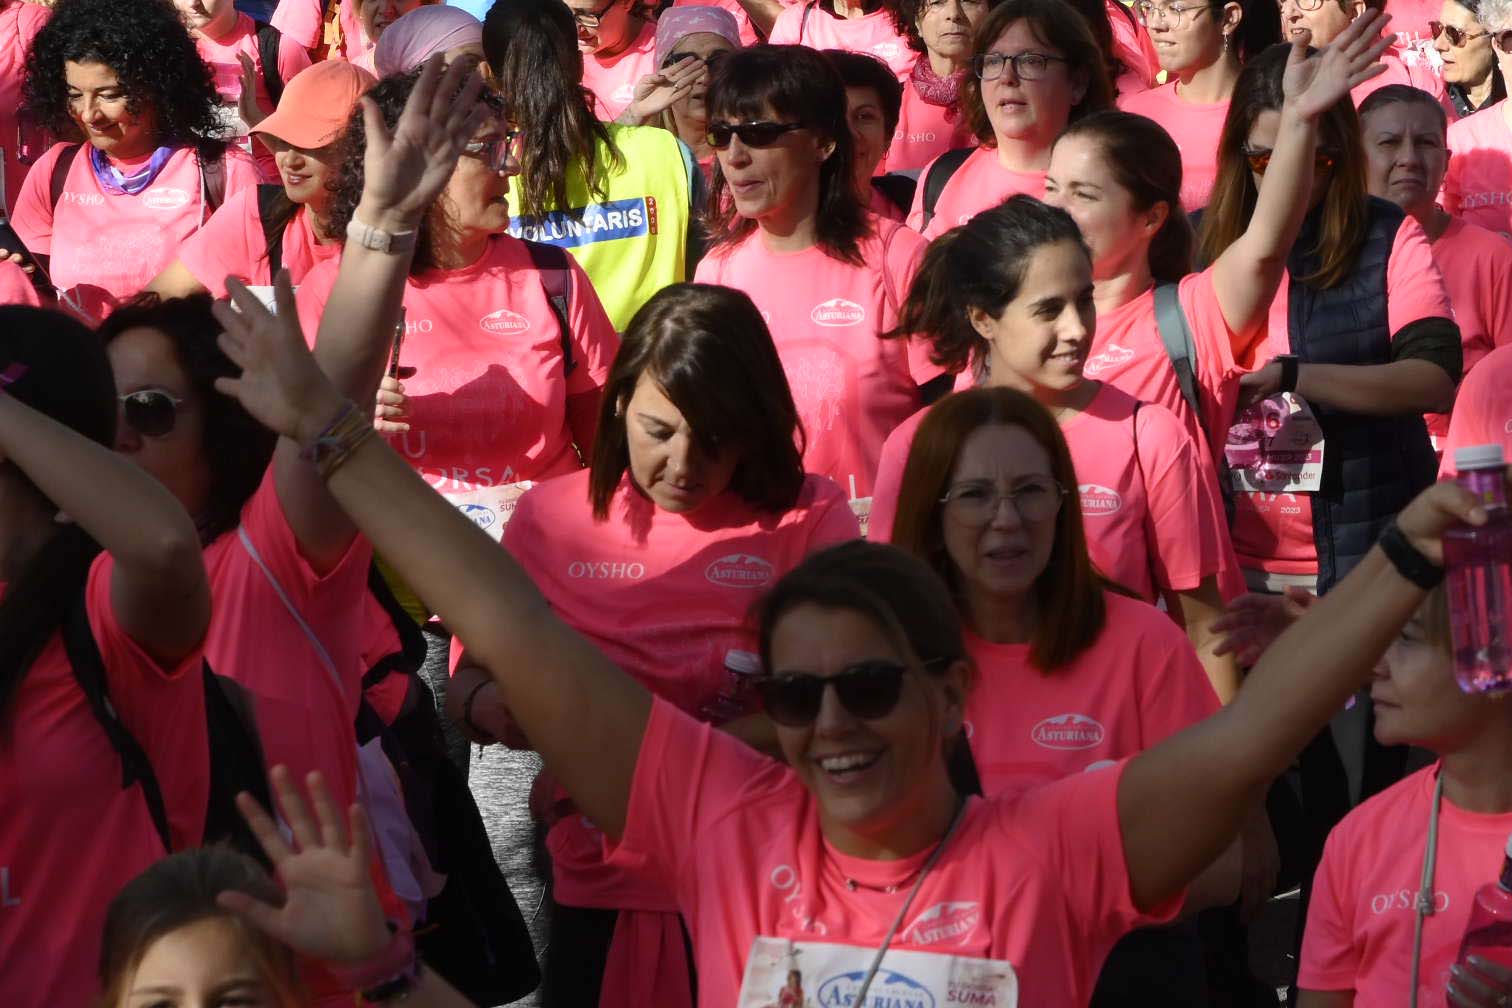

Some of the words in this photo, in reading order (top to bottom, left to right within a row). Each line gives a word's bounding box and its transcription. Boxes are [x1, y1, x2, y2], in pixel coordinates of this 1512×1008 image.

[894, 129, 936, 144] OSHO
[567, 561, 646, 580] OYSHO
[947, 989, 997, 1007] SUMA
